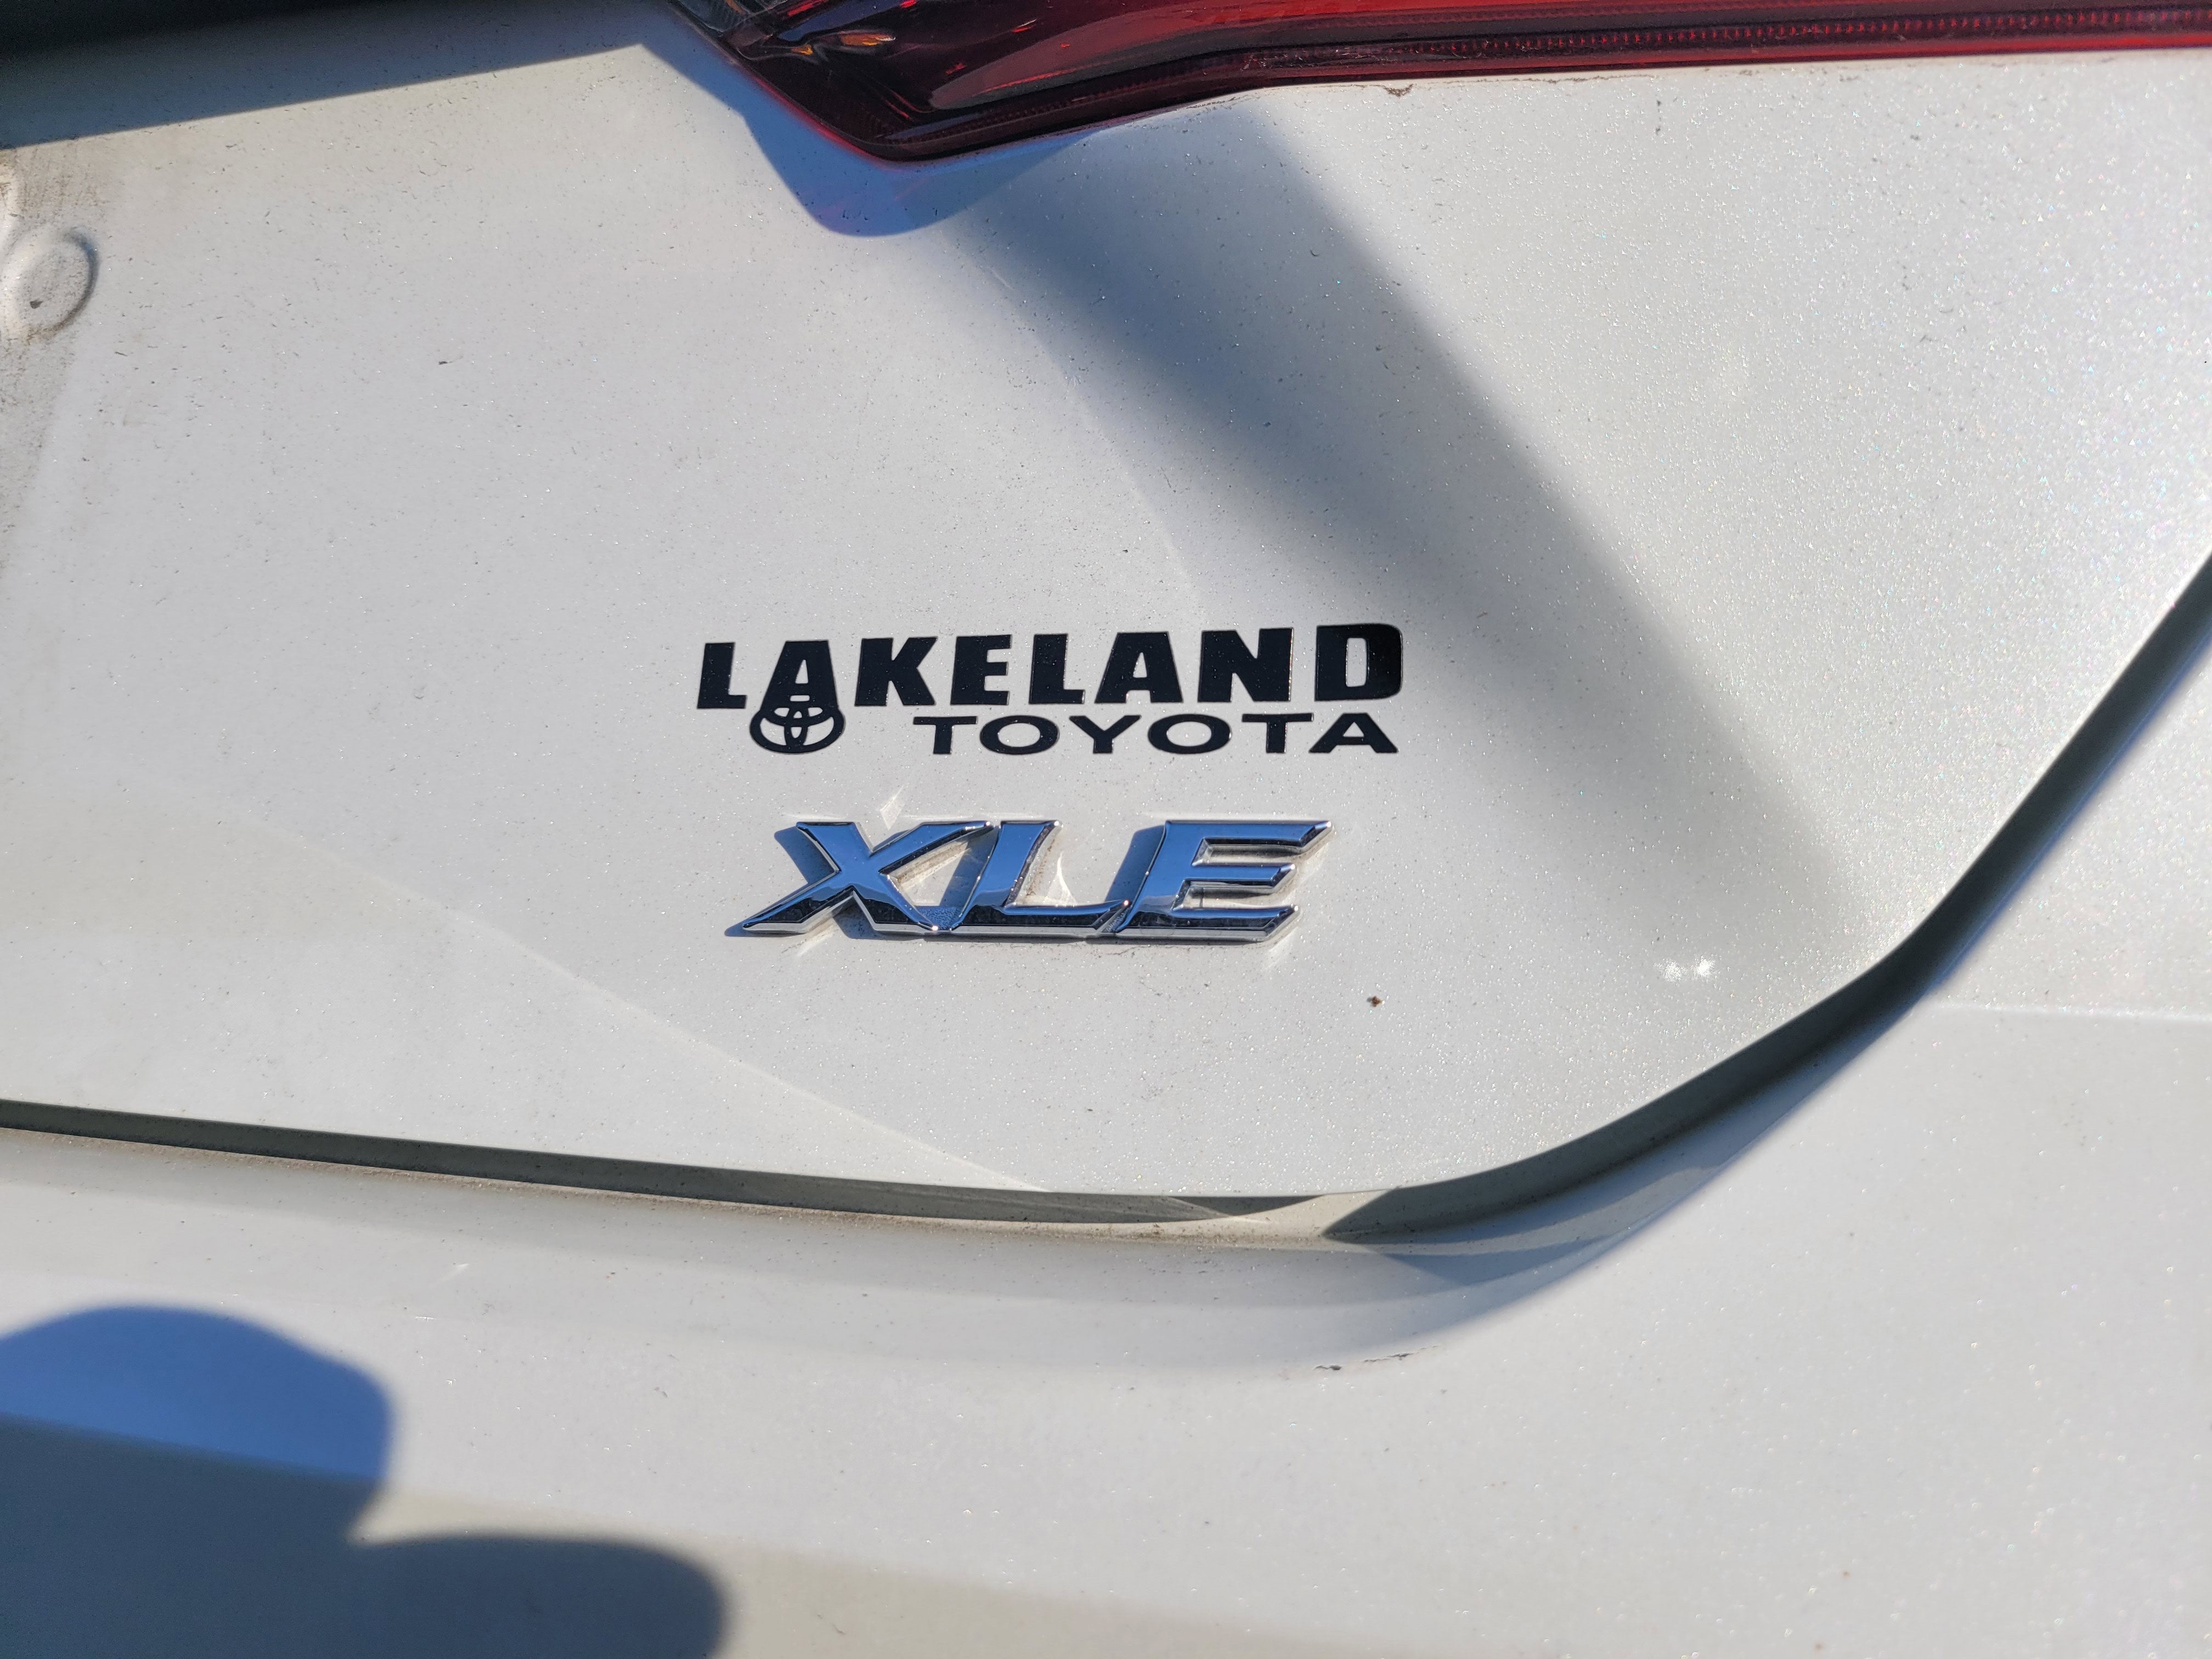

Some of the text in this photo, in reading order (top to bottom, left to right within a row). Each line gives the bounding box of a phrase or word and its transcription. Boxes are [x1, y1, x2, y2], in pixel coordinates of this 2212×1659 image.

[696, 623, 1404, 709] LAKELAND
[913, 713, 1398, 755] TOYOTA
[741, 820, 1334, 944] XLE
